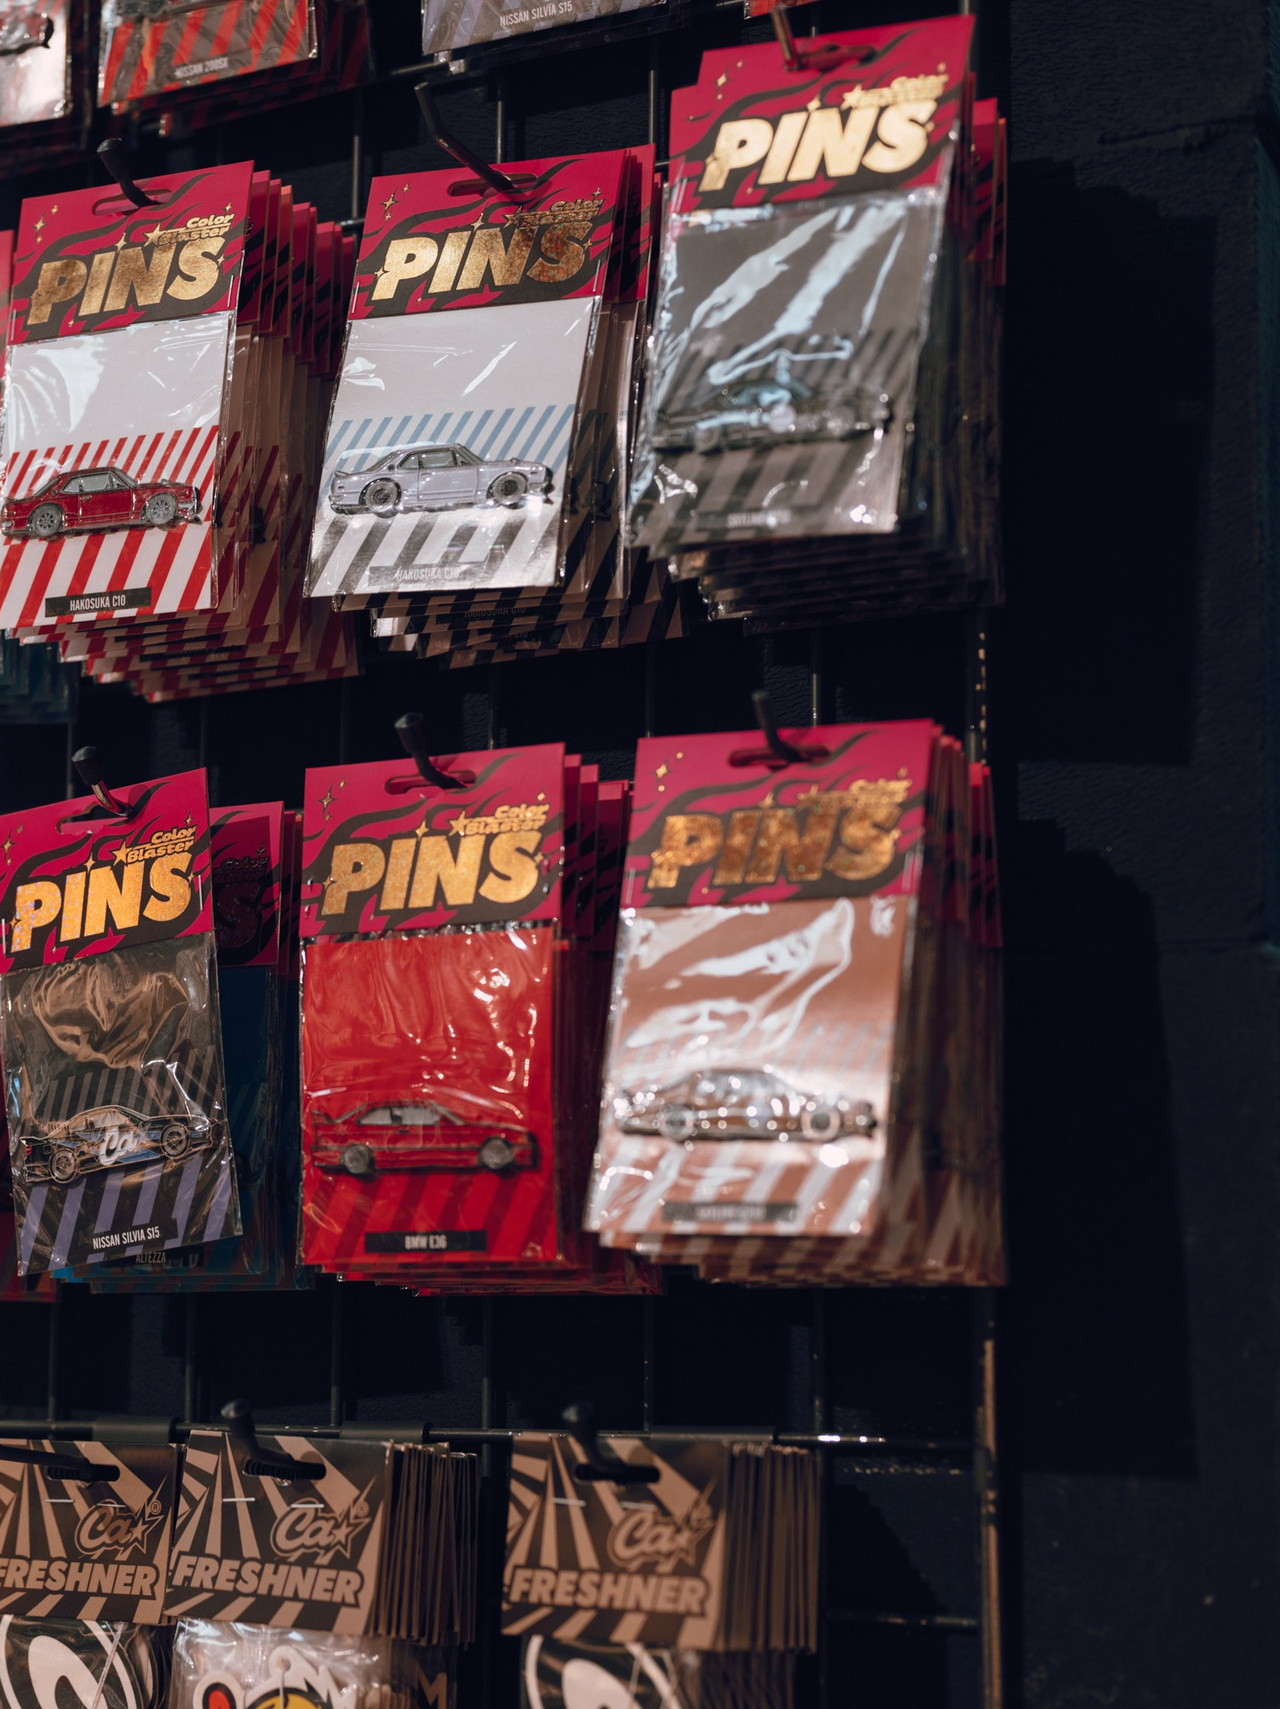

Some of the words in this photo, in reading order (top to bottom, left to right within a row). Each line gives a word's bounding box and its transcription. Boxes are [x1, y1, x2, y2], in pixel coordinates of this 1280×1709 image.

[500, 10, 529, 27] NISSAN
[531, 4, 557, 20] SILVIA
[558, 2, 573, 14] S15
[698, 99, 938, 193] PINS
[551, 198, 605, 213] Color
[186, 213, 235, 230] Color
[158, 225, 231, 246] Blaster
[371, 221, 593, 301] PINS
[27, 236, 226, 326] PINS
[395, 567, 442, 582] HAKOSUKA
[69, 596, 111, 612] HAKOSUKA
[112, 594, 126, 607] C10
[494, 804, 550, 820] Color
[151, 825, 197, 845] Color
[647, 803, 903, 889] PINS
[126, 840, 194, 865] Blaster
[321, 830, 543, 916] PINS
[10, 852, 193, 954] PINS
[92, 1233, 121, 1250] NISSAN
[121, 1228, 146, 1245] SILVIA
[146, 1225, 161, 1240] S15
[404, 1235, 428, 1250] BMW
[428, 1234, 448, 1249] E36
[135, 1251, 167, 1264] ALTEZZA
[171, 1554, 363, 1605] FRESHNER
[508, 1566, 708, 1614] FRESHNER
